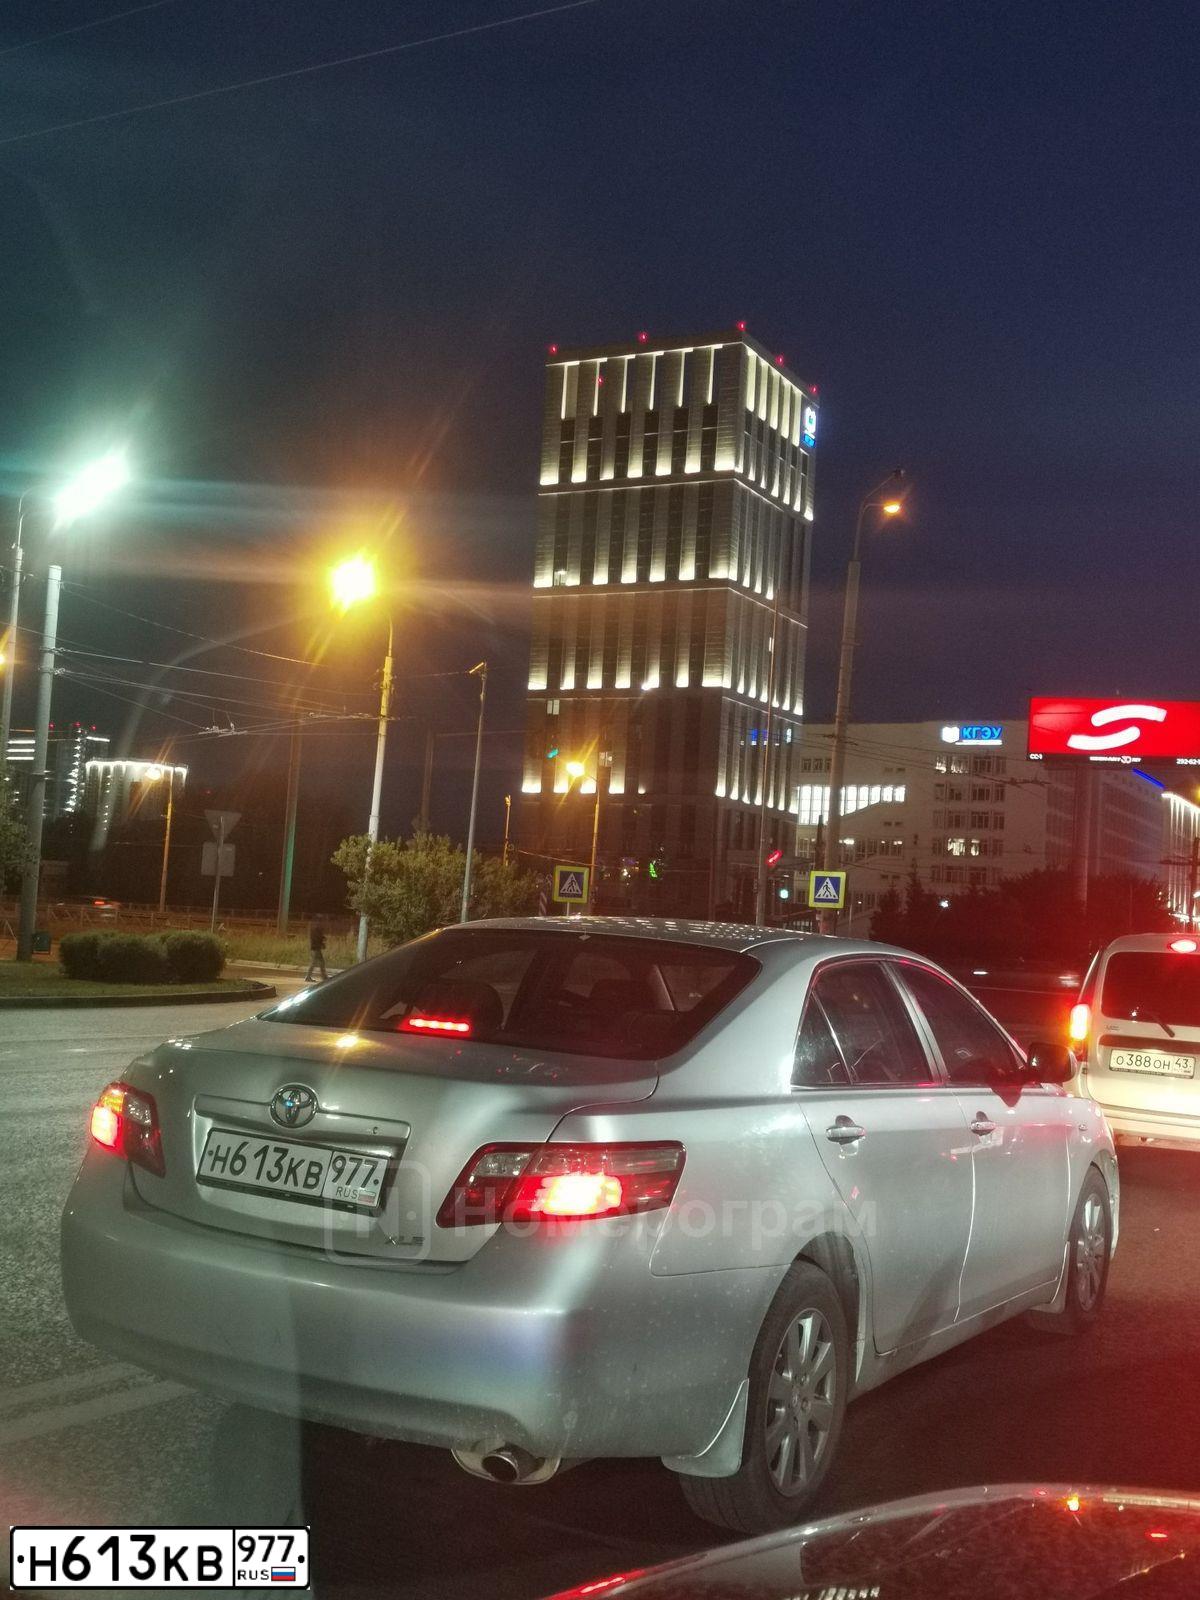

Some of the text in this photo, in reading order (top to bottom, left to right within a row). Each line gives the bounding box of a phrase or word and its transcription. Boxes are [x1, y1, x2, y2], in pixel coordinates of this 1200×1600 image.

[962, 726, 1002, 739] КГЭУ
[209, 1141, 379, 1190] Н613КВ 977
[335, 1187, 358, 1200] RUS
